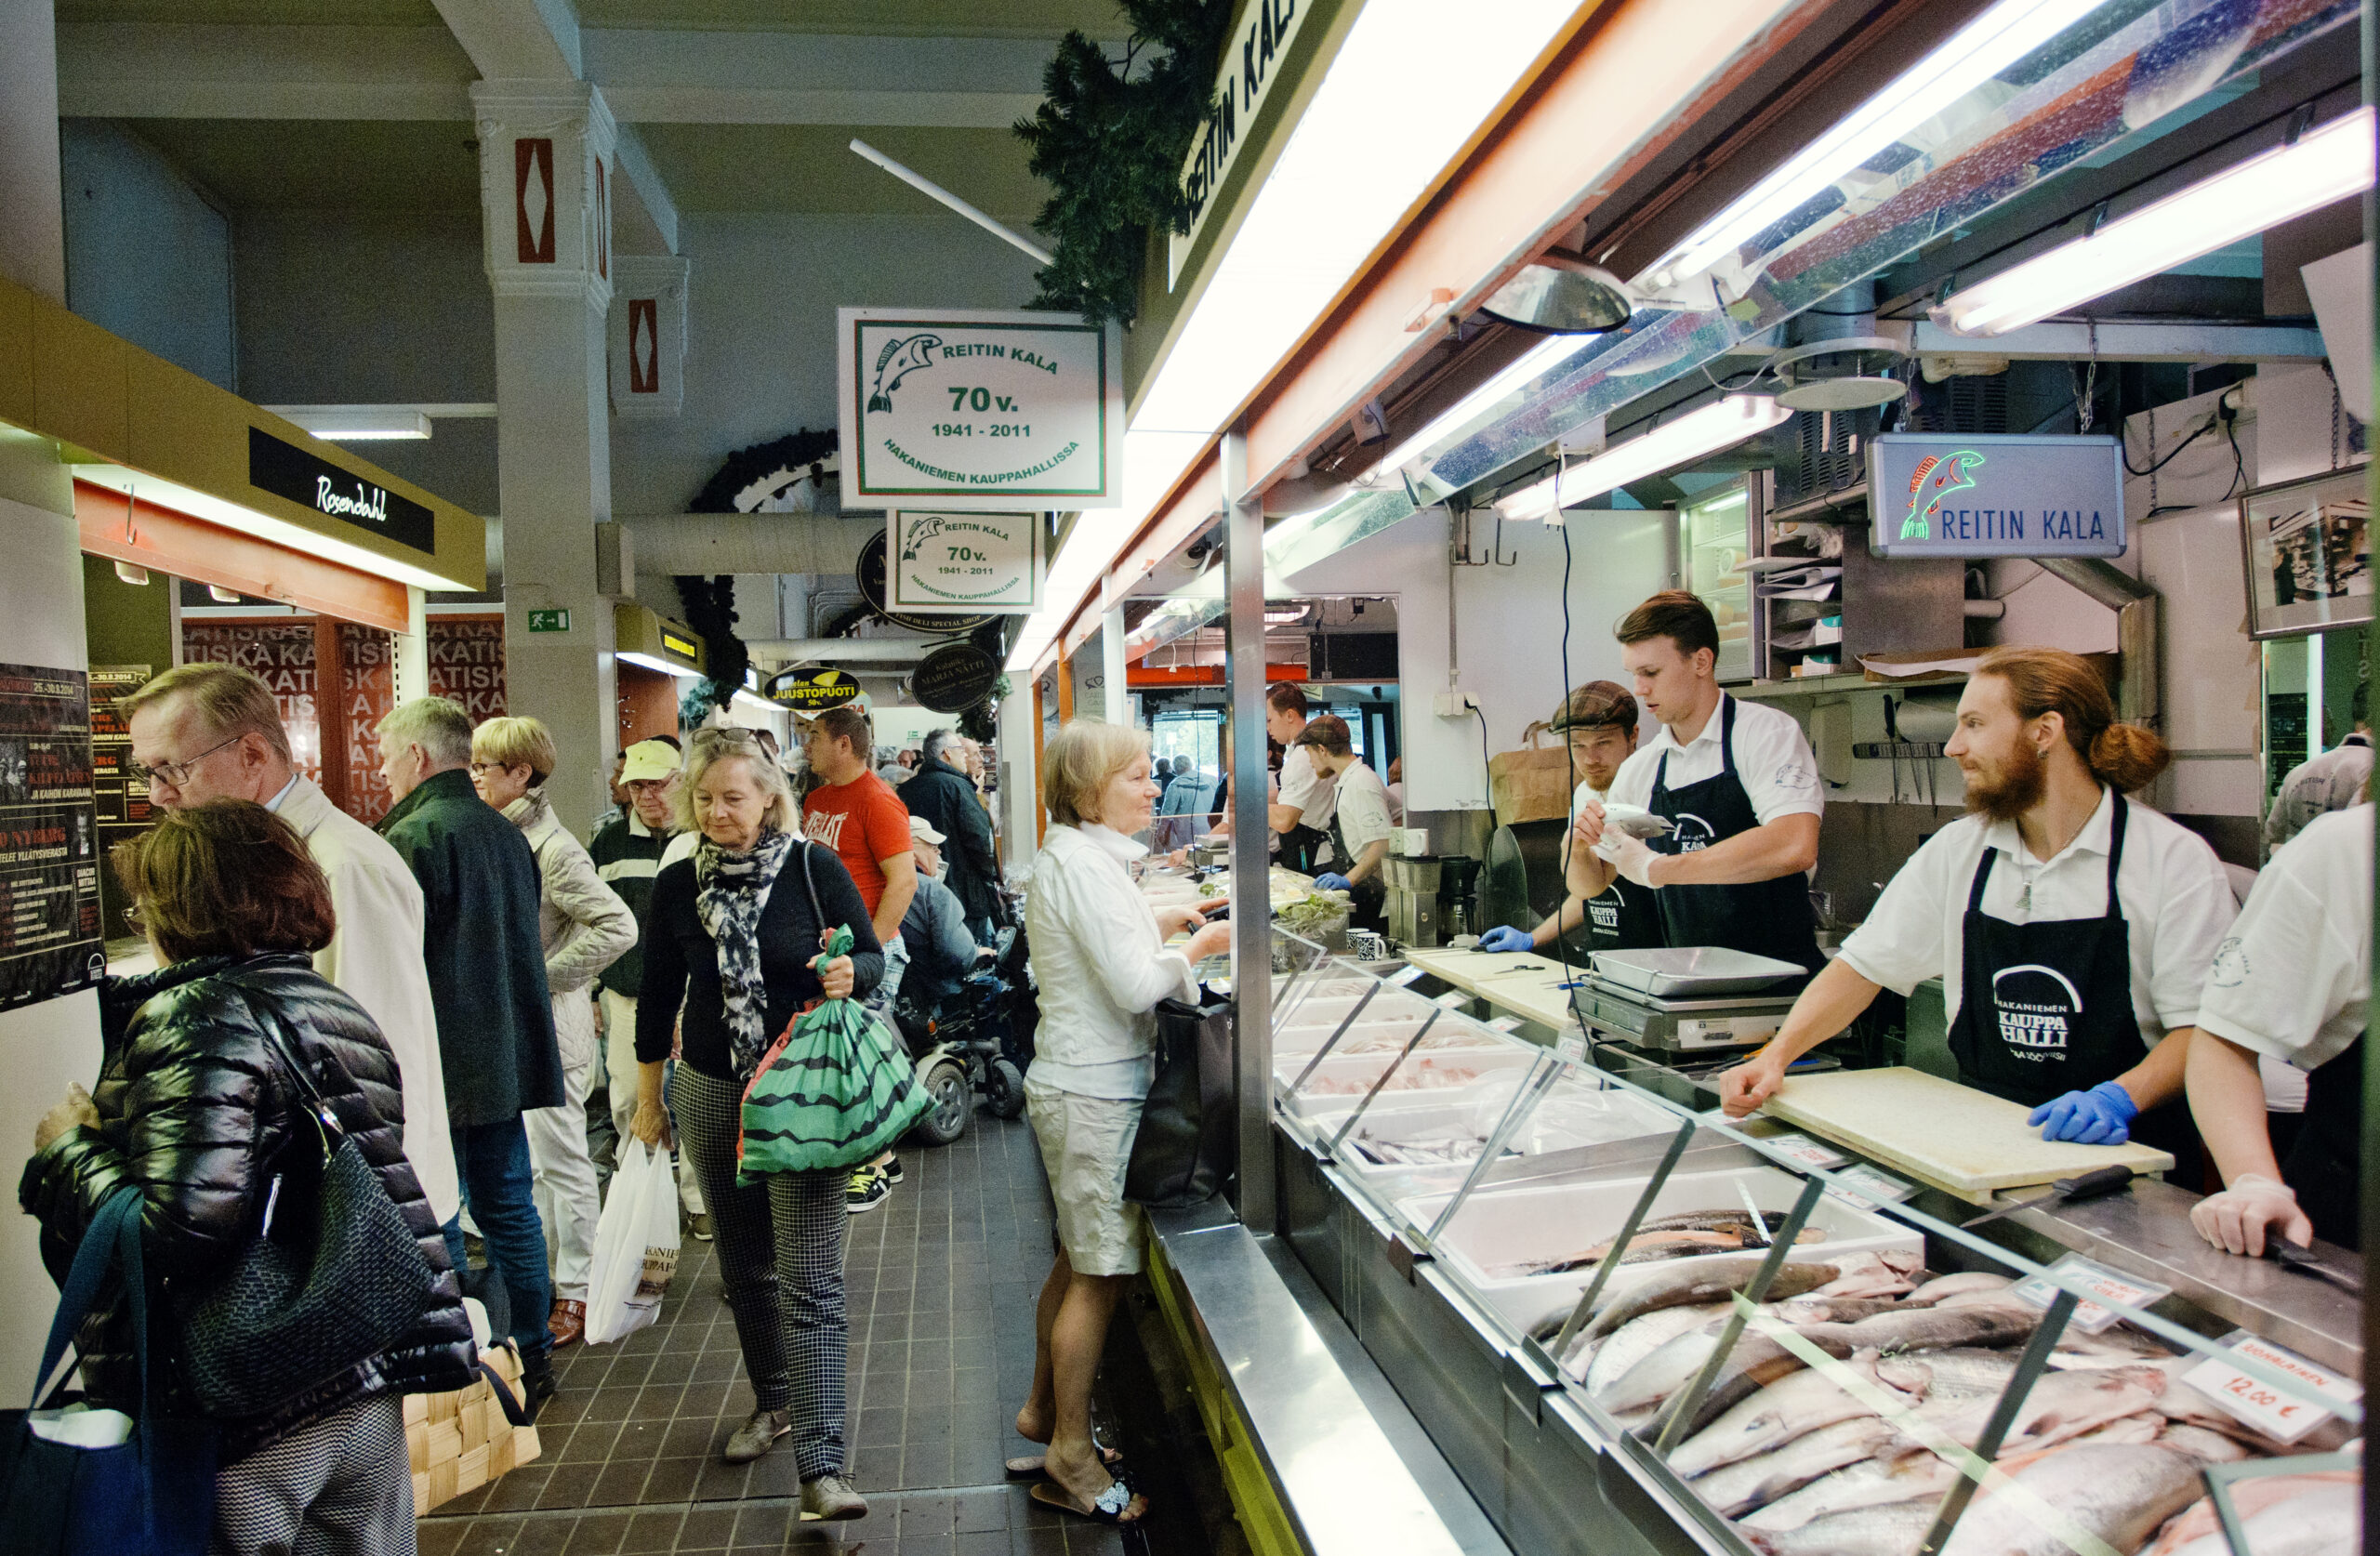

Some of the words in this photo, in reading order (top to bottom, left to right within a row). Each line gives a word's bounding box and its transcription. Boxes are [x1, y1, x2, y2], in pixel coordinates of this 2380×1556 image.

[943, 343, 1005, 359] REITIN
[1011, 344, 1058, 375] KALA
[947, 387, 991, 413] 70
[995, 395, 1019, 412] v.
[932, 424, 972, 437] 1941
[989, 424, 1030, 437] 2011
[883, 438, 966, 483] HAKANIEMEN
[969, 440, 1079, 484] KAUPPAHALLISSA
[317, 475, 386, 521] Rosendahl
[945, 522, 979, 532] REITIN
[983, 524, 1010, 542] KALA
[1942, 509, 2024, 539] REITIN
[2043, 509, 2104, 539] KALA
[947, 547, 972, 561] 70
[973, 551, 987, 561] v.
[938, 566, 960, 574] 1941
[970, 566, 993, 574] 2011
[911, 574, 956, 600] HAKANIEMEN
[958, 576, 1020, 600] KAUPPAHALLISSA
[913, 618, 931, 626] DELI
[962, 615, 981, 626] SHOP
[773, 687, 855, 699] JUUSTOPUOTI
[1998, 1000, 2068, 1013] HAKANIEMEN
[1999, 1010, 2069, 1031] KAUPPA
[2000, 1024, 2069, 1048] HALLI
